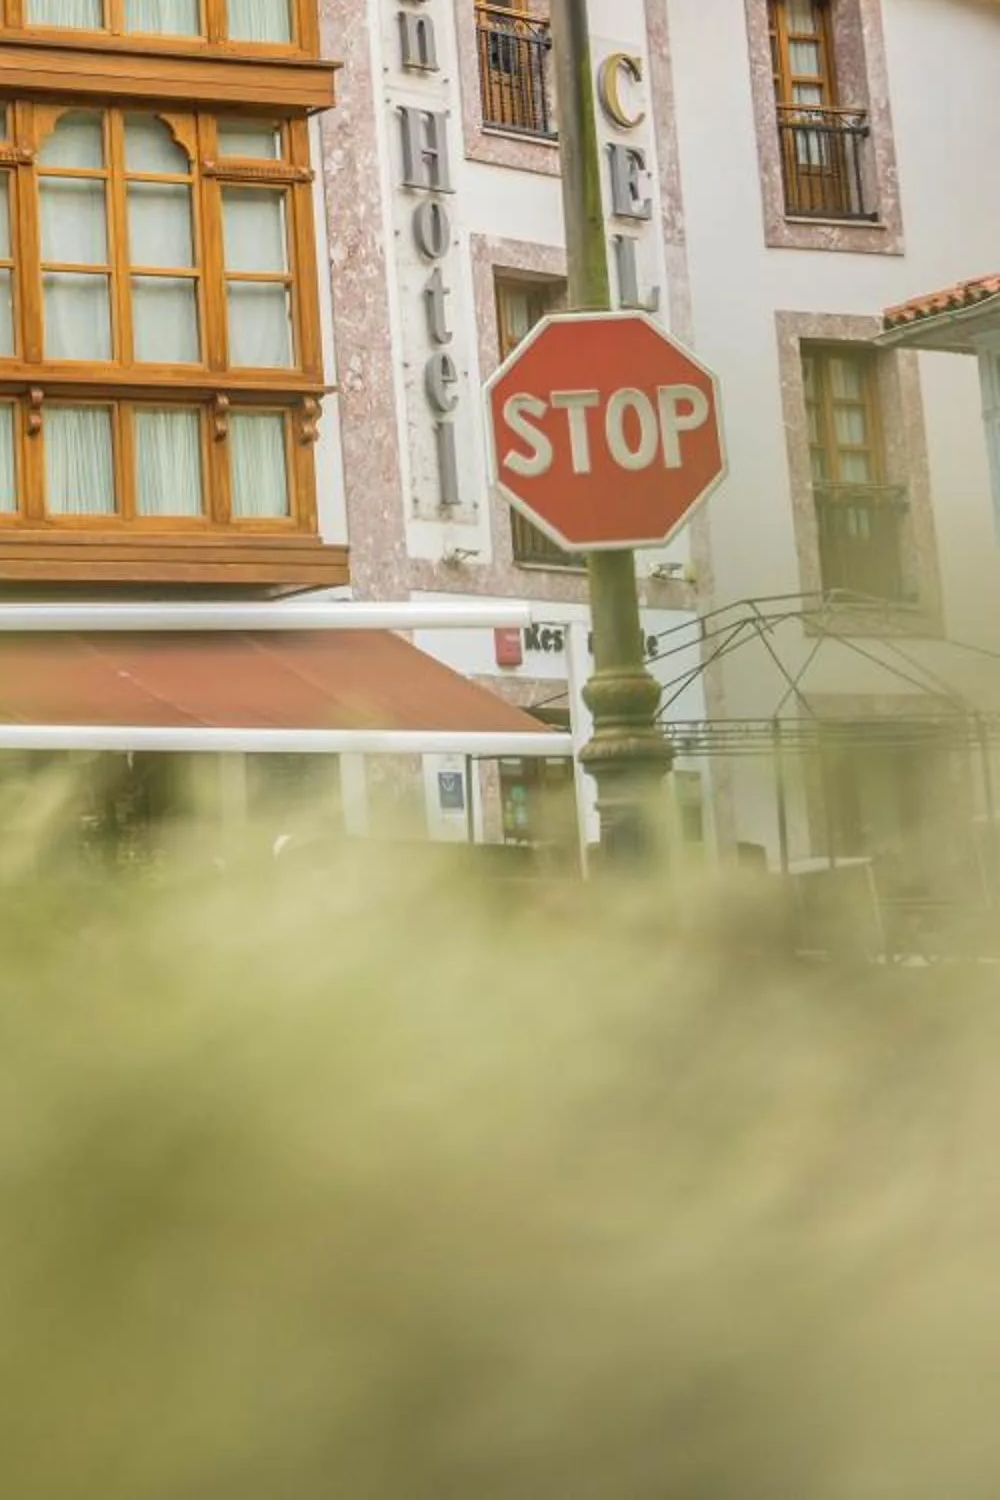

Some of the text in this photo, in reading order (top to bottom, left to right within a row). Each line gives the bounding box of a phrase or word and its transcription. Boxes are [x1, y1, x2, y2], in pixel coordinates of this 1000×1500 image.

[396, 105, 461, 505] Hotel
[597, 53, 660, 313] CEL
[503, 383, 708, 476] STOP
